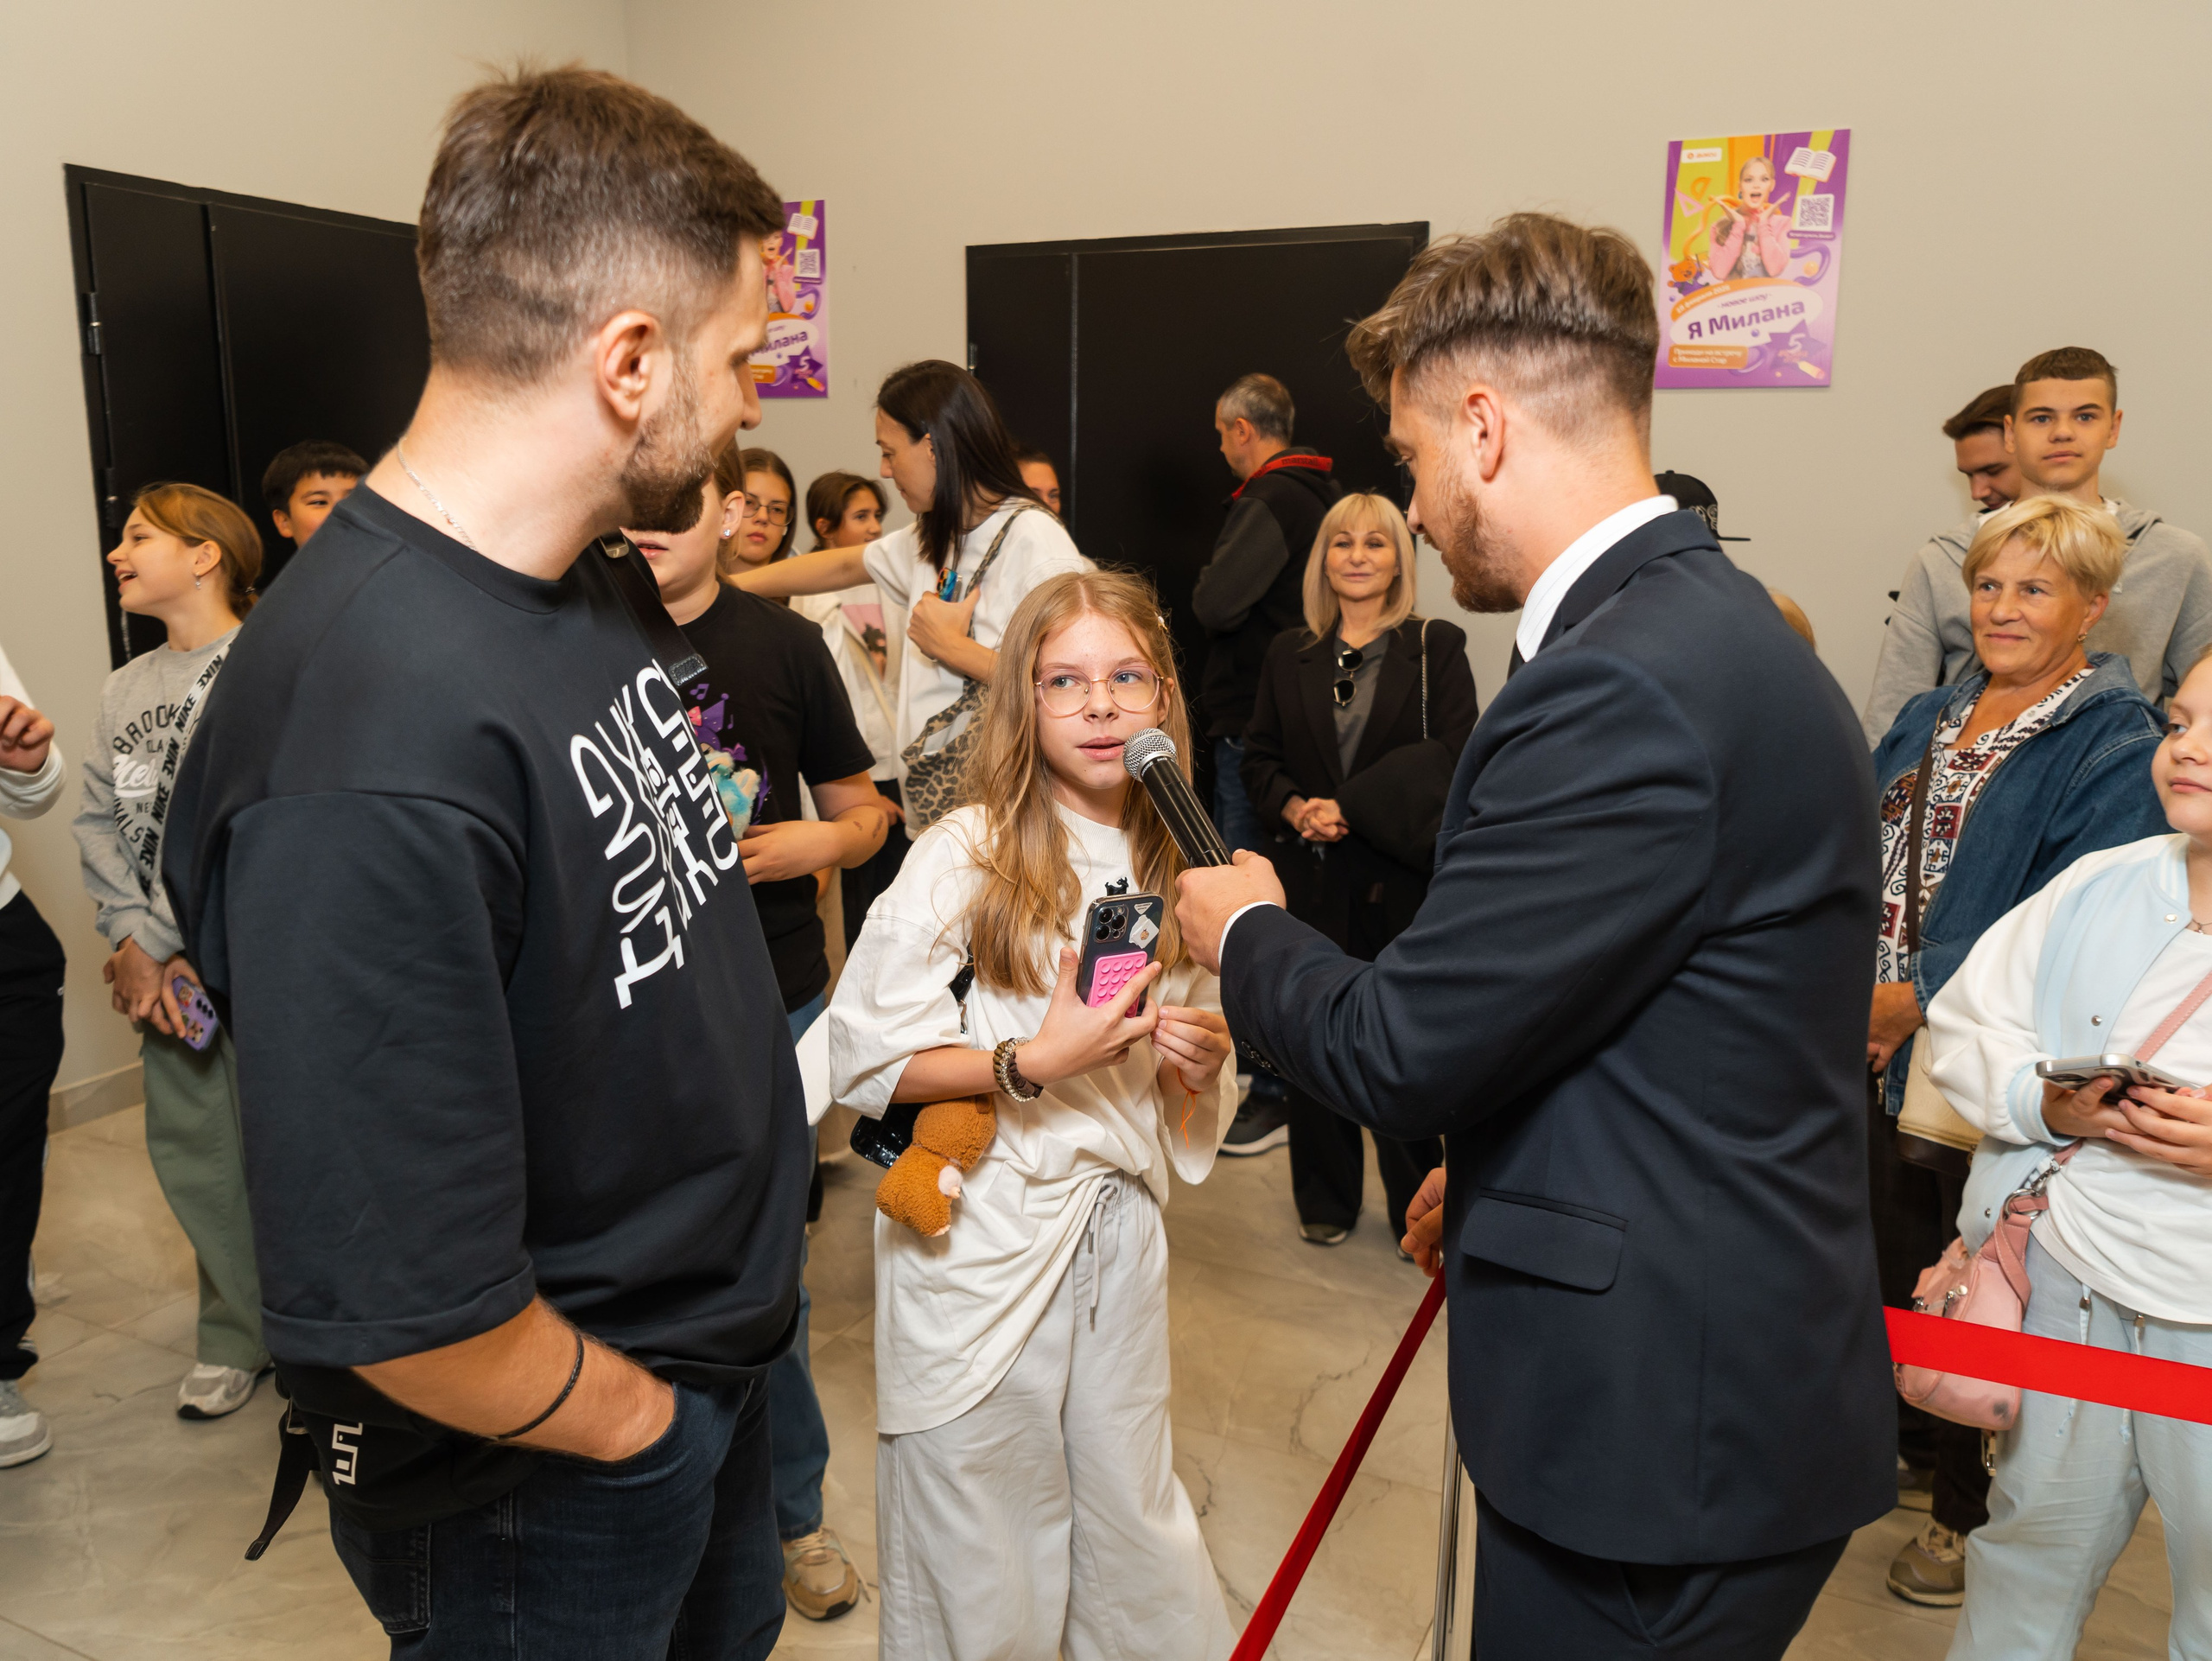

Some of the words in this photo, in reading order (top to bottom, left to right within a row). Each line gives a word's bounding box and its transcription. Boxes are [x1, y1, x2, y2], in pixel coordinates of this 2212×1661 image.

[1688, 321, 1702, 340] Я
[1708, 301, 1805, 335] Милана
[752, 331, 808, 355] илана
[1789, 333, 1806, 353] 5
[196, 654, 223, 690] NIKE
[175, 694, 196, 734] NIKE
[162, 737, 180, 780] NIKE
[150, 782, 170, 824] NIKE
[139, 826, 160, 870] NIKE
